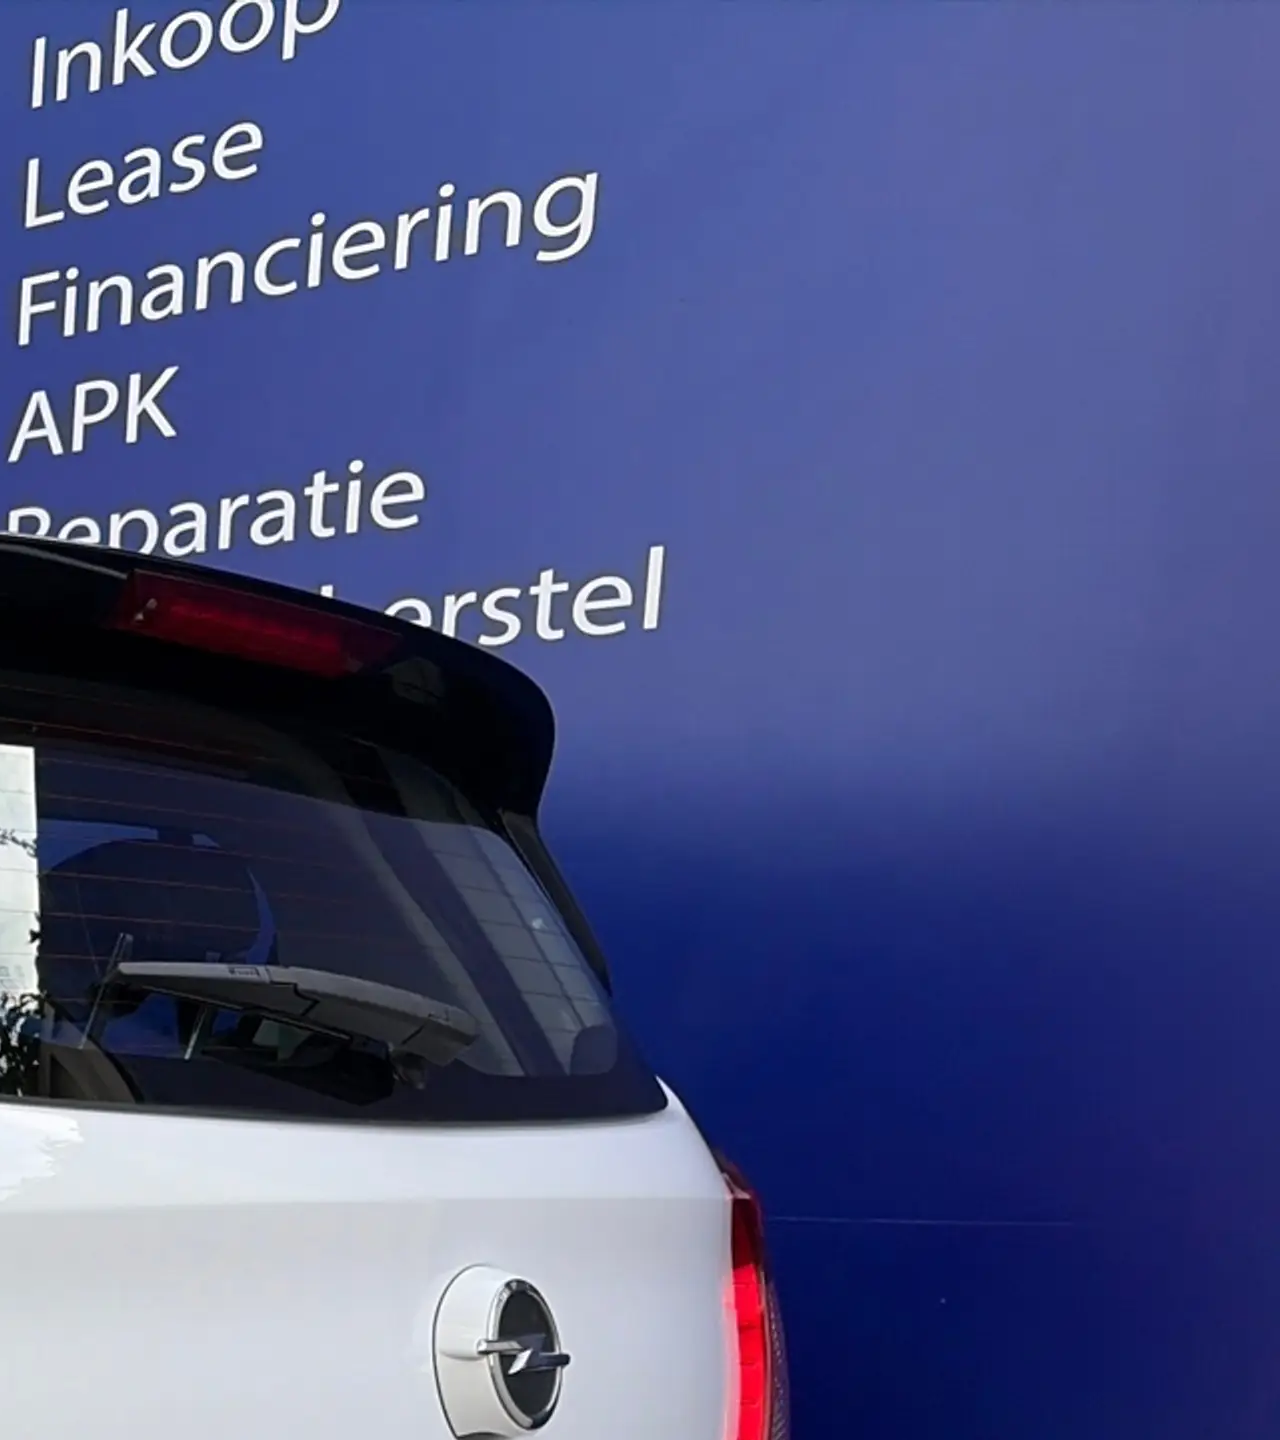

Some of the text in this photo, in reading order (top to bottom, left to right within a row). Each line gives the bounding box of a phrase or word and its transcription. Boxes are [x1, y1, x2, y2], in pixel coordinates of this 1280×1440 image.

[32, 0, 339, 108] Inkoop
[23, 119, 263, 228] Lease
[17, 172, 598, 345] Financiering
[8, 366, 178, 462] APK
